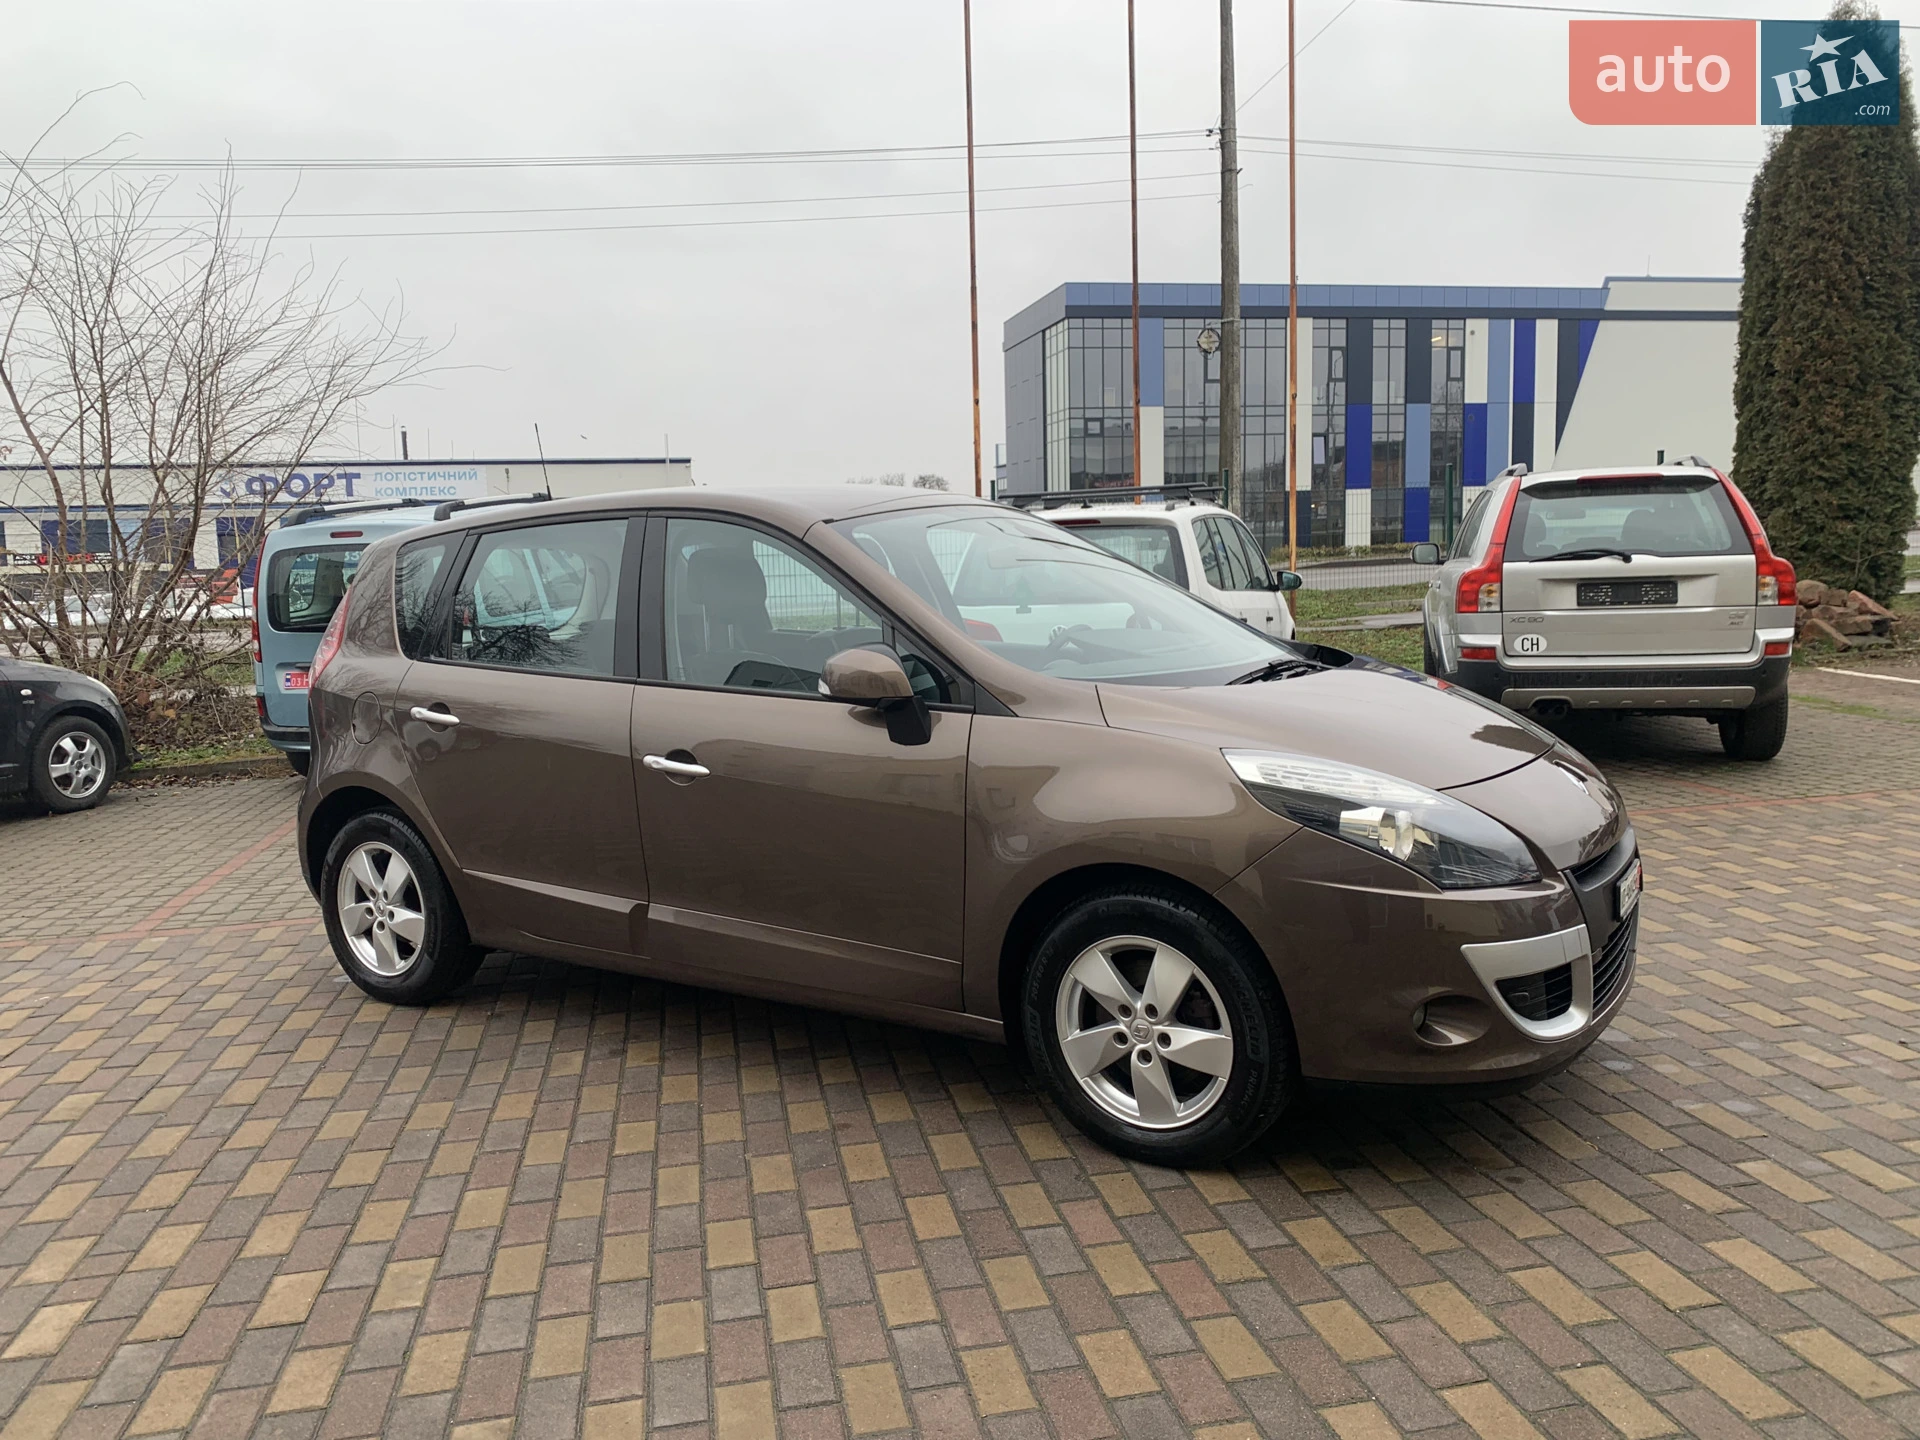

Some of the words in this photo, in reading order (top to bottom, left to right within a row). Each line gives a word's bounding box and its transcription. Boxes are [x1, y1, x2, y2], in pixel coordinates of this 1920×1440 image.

[373, 468, 478, 482] ЛОГІСТИЧНИЙ
[245, 472, 361, 498] ФОРТ
[375, 486, 457, 497] КОМПЛЕКС
[1521, 637, 1539, 652] CH
